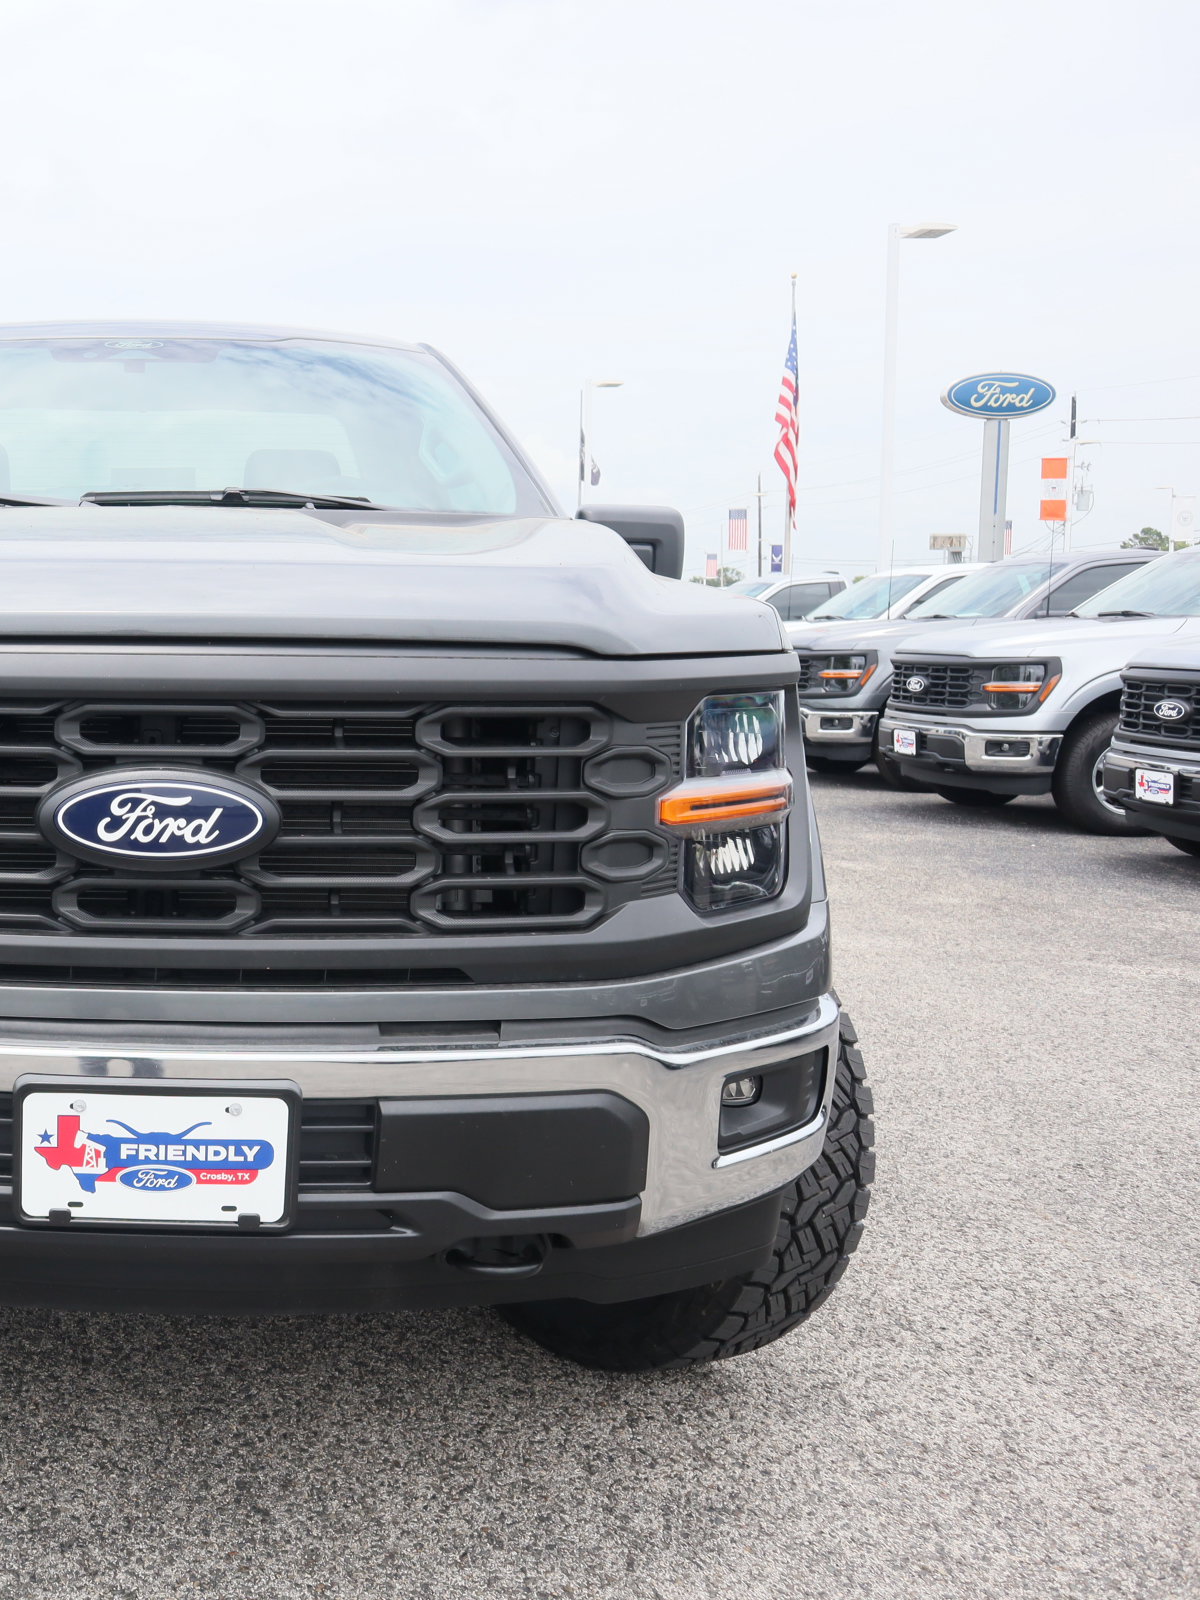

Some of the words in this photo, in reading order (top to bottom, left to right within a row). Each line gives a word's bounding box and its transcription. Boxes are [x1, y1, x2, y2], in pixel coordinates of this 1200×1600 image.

[970, 380, 1036, 408] Ford
[1159, 703, 1179, 717] Ford
[96, 792, 224, 844] Ford
[119, 1142, 261, 1163] FRIENDLY
[132, 1169, 179, 1189] Ford
[199, 1171, 236, 1182] Crosby,
[237, 1172, 251, 1181] TX
